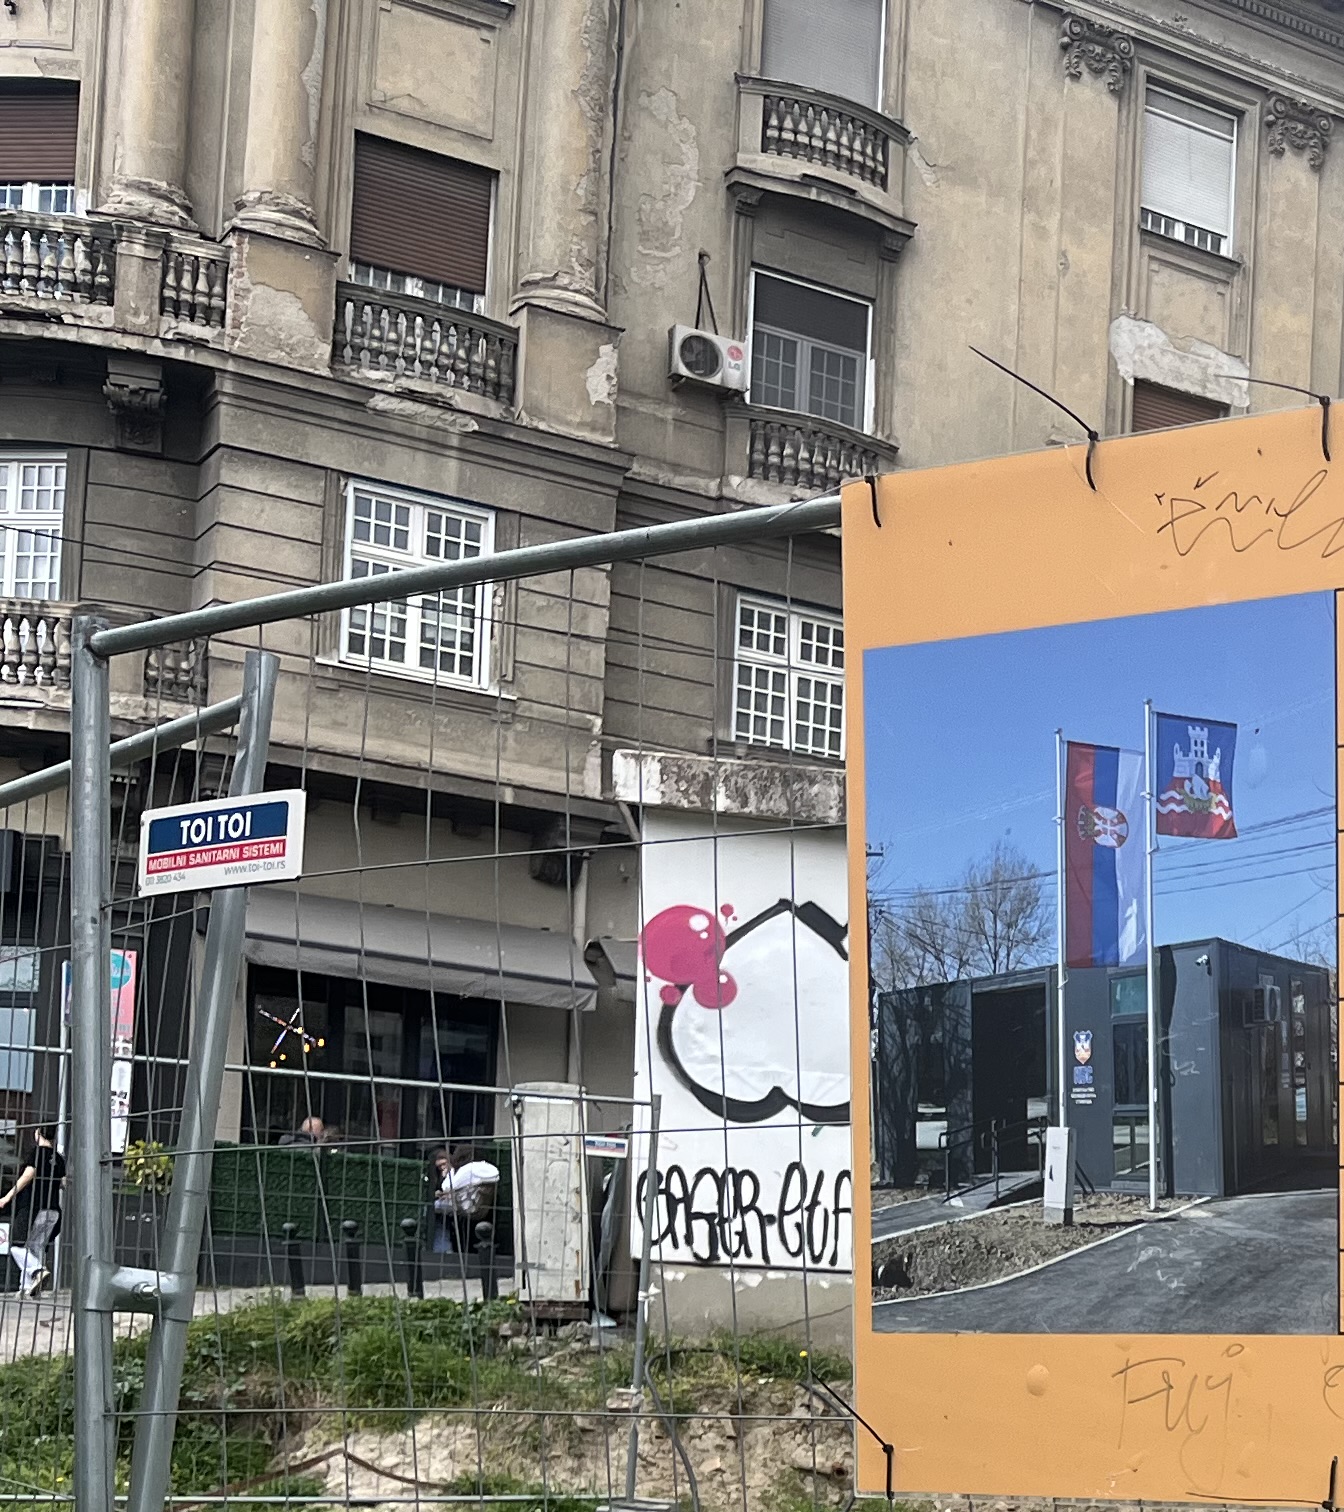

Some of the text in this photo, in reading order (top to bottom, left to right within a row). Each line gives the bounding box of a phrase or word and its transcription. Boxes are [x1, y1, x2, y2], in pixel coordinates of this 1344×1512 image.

[180, 811, 252, 845] TOI TOI
[148, 842, 284, 872] MOBILNI SANITARNI SISTEMI
[224, 859, 286, 875] www.toi-toi.rs
